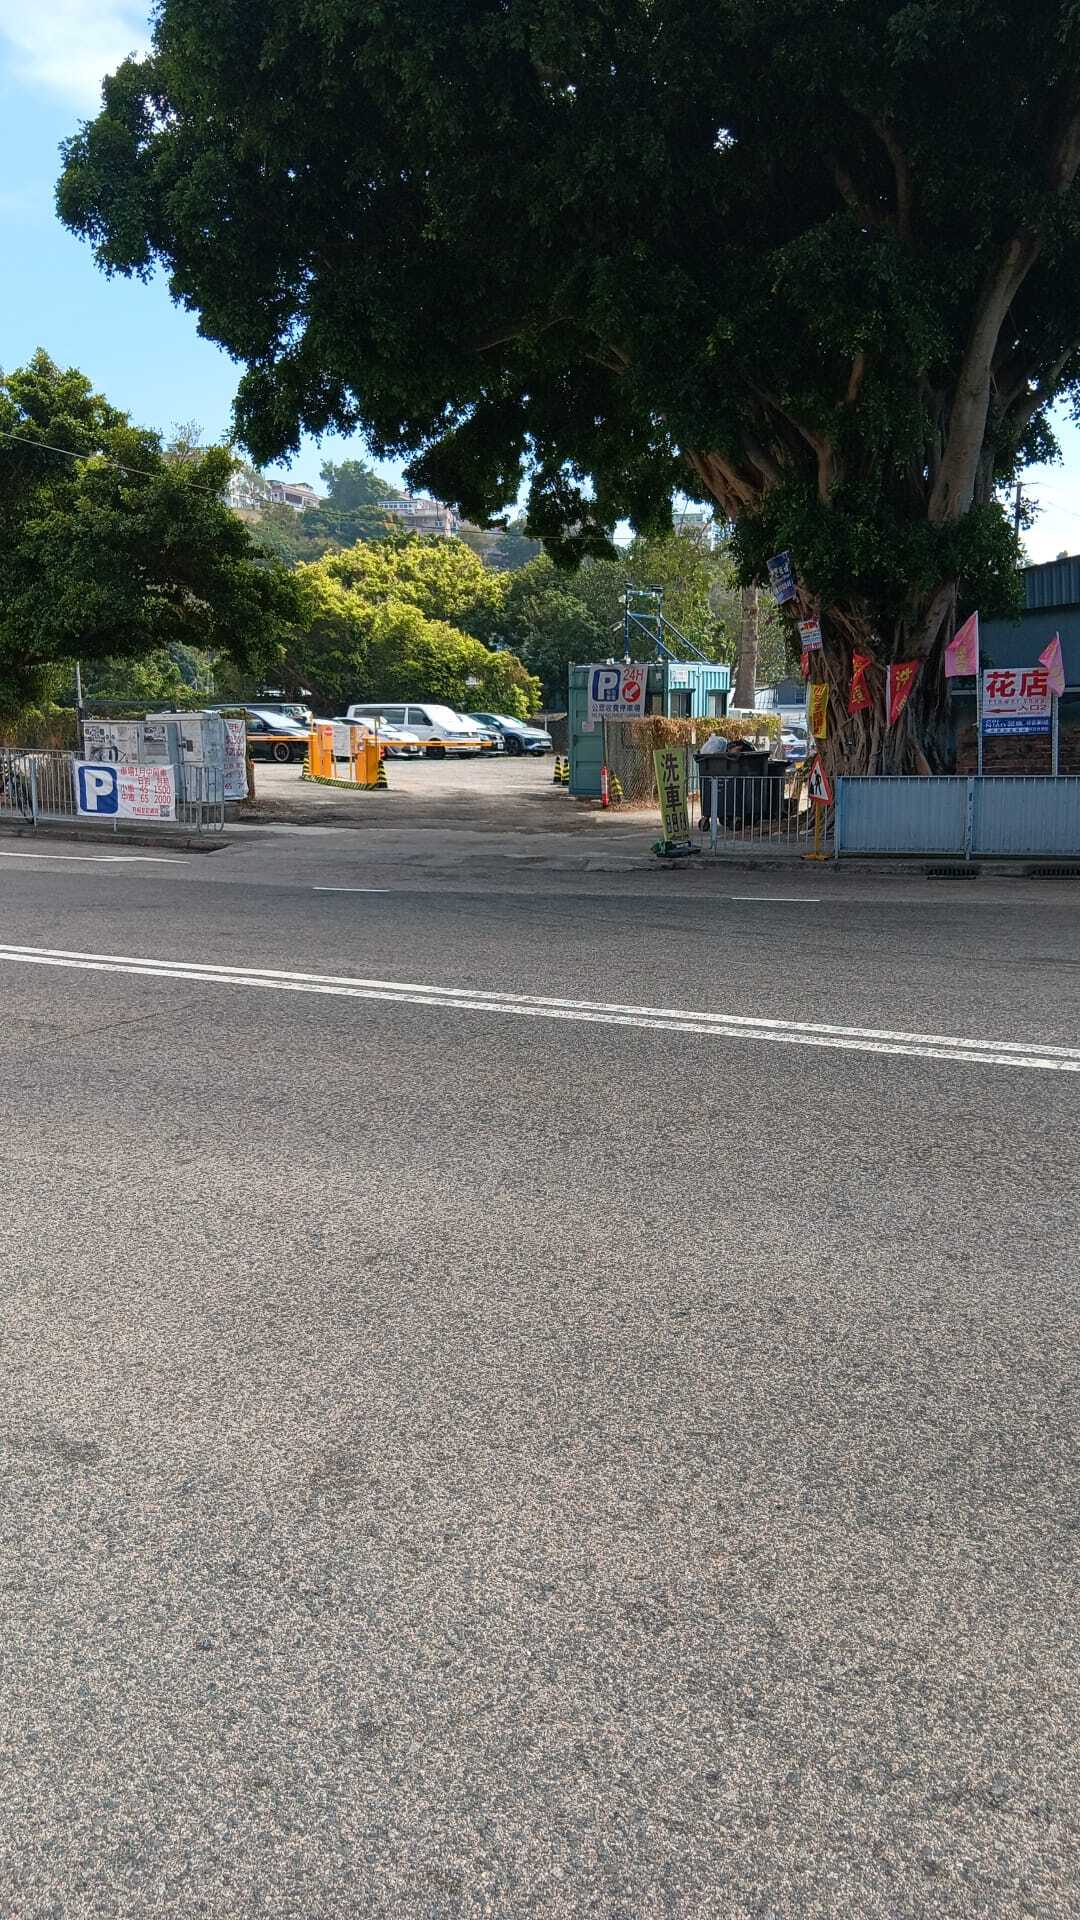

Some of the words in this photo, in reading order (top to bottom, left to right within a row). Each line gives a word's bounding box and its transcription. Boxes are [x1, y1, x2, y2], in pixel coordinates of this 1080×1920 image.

[597, 671, 618, 700] P
[623, 669, 644, 681] 24H
[986, 670, 1049, 698] 花店
[84, 769, 114, 811] P
[154, 785, 171, 795] 1500
[660, 753, 683, 812] 洗車
[140, 794, 149, 804] 65
[154, 794, 172, 805] 2000
